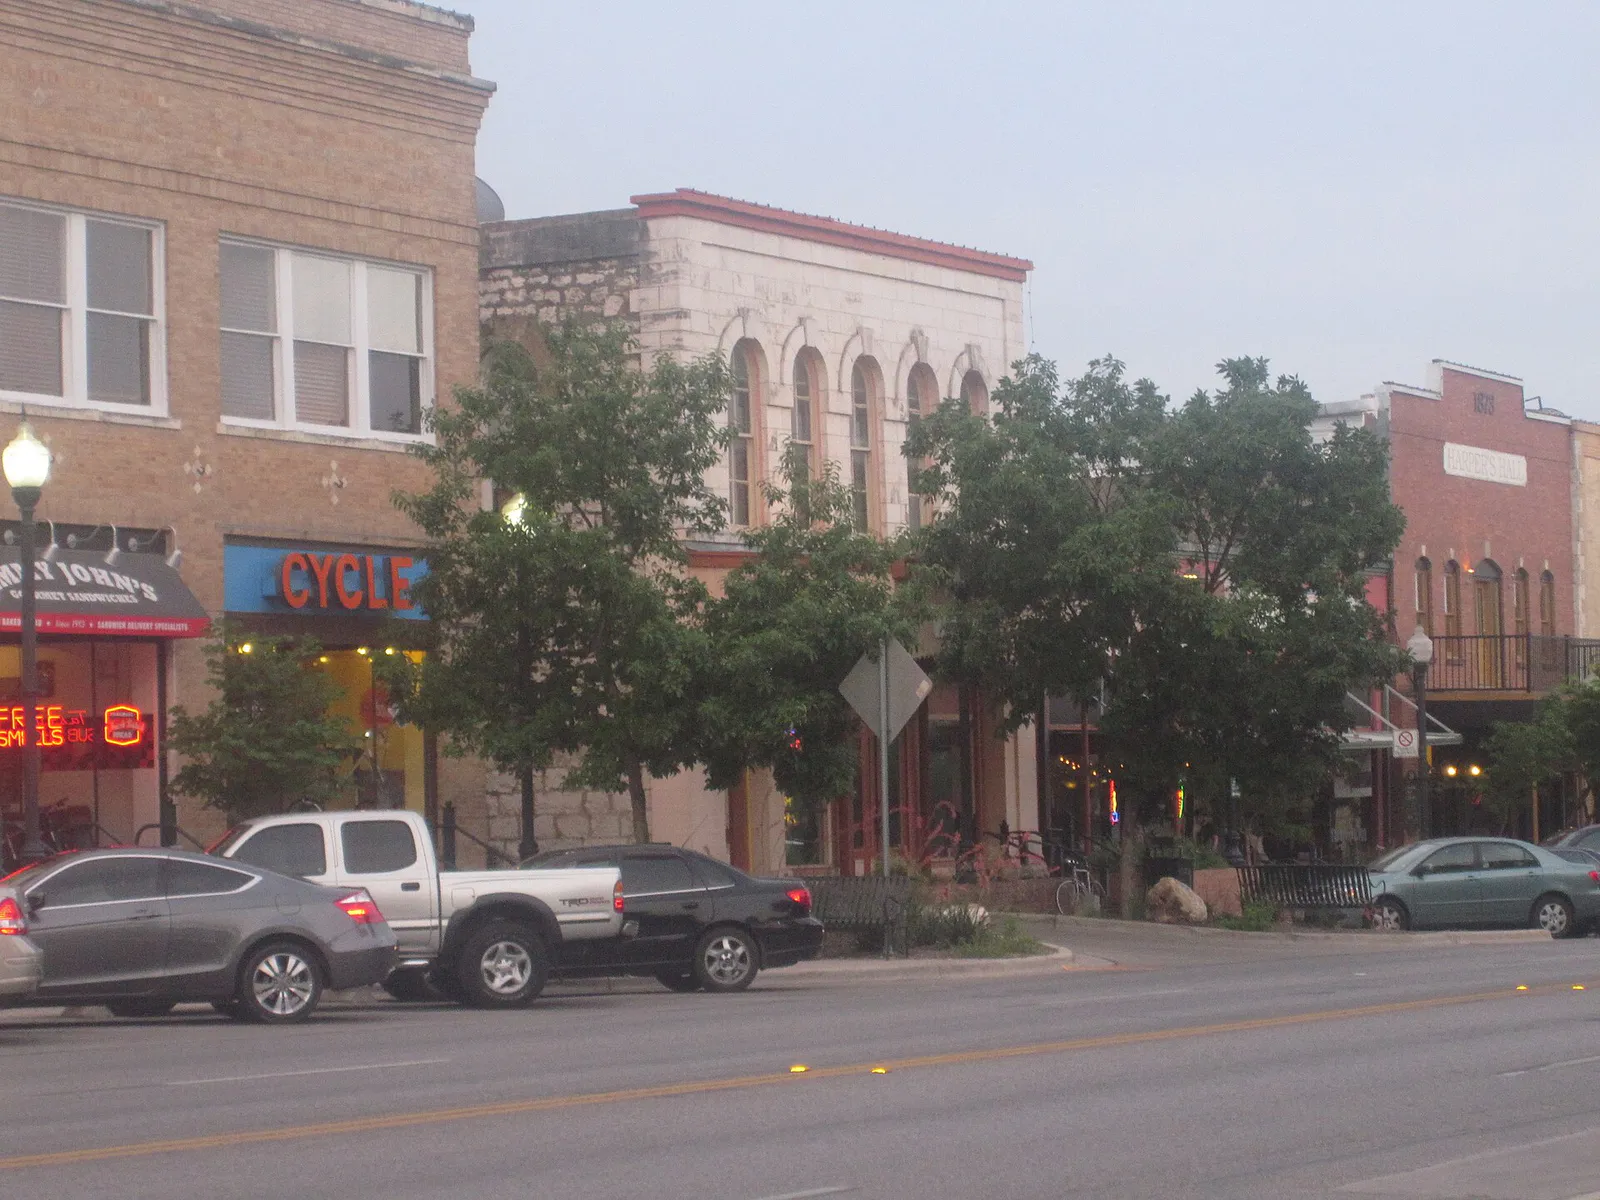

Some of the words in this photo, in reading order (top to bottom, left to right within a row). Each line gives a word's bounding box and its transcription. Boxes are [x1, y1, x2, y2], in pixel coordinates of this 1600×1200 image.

[56, 562, 158, 602] JOHN'S
[282, 552, 414, 610] CYCLE
[9, 589, 66, 601] GRMET
[67, 592, 138, 603] SANDWICHES
[0, 729, 64, 747] SMLS
[559, 898, 589, 907] TRD
